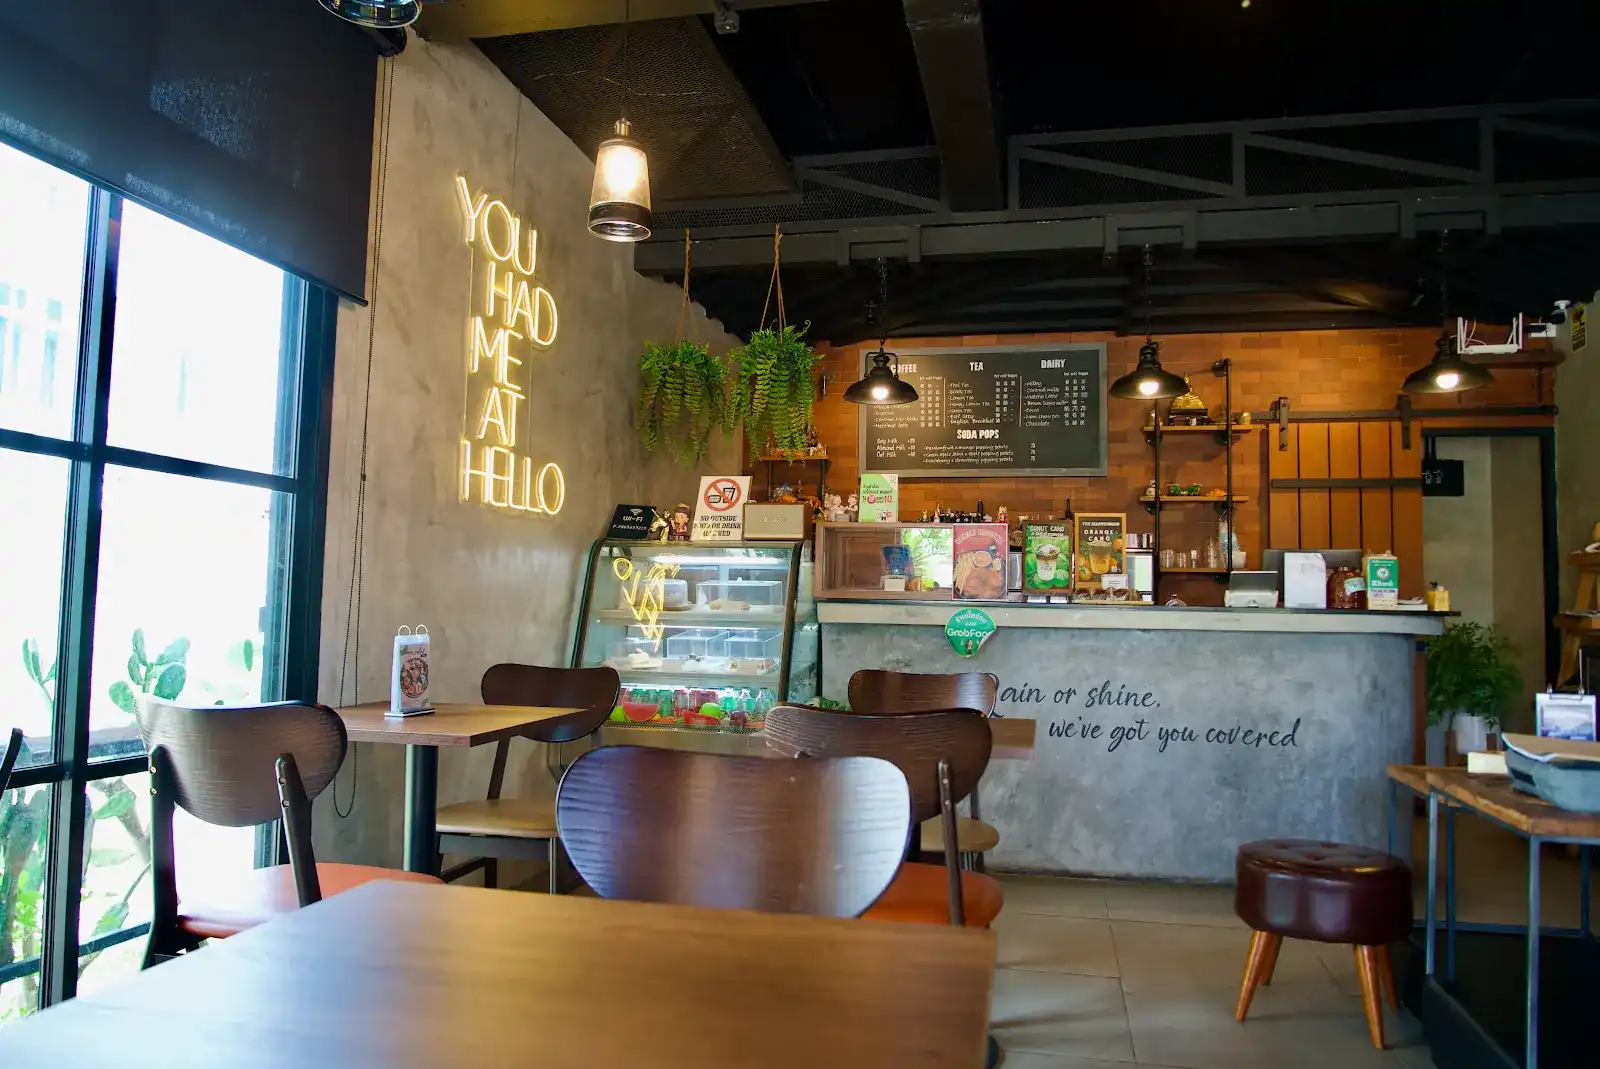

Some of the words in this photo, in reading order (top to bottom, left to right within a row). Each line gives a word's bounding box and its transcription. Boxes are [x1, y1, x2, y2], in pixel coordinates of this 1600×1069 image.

[456, 172, 537, 275] YOU
[487, 261, 558, 345] HAD
[469, 315, 523, 391] ME
[890, 363, 917, 373] COFFEE
[969, 361, 984, 371] TEA
[1040, 358, 1066, 369] DAIRY
[476, 386, 525, 447] AT
[956, 429, 977, 440] SODA
[979, 429, 1000, 439] POPS
[460, 440, 565, 516] HELLO
[946, 628, 988, 637] GrabFoo
[1053, 686, 1077, 704] or
[1085, 680, 1160, 708] shine,
[1049, 716, 1104, 739] we've
[1108, 719, 1149, 752] got
[1157, 731, 1200, 753] you
[1205, 718, 1302, 748] covered
